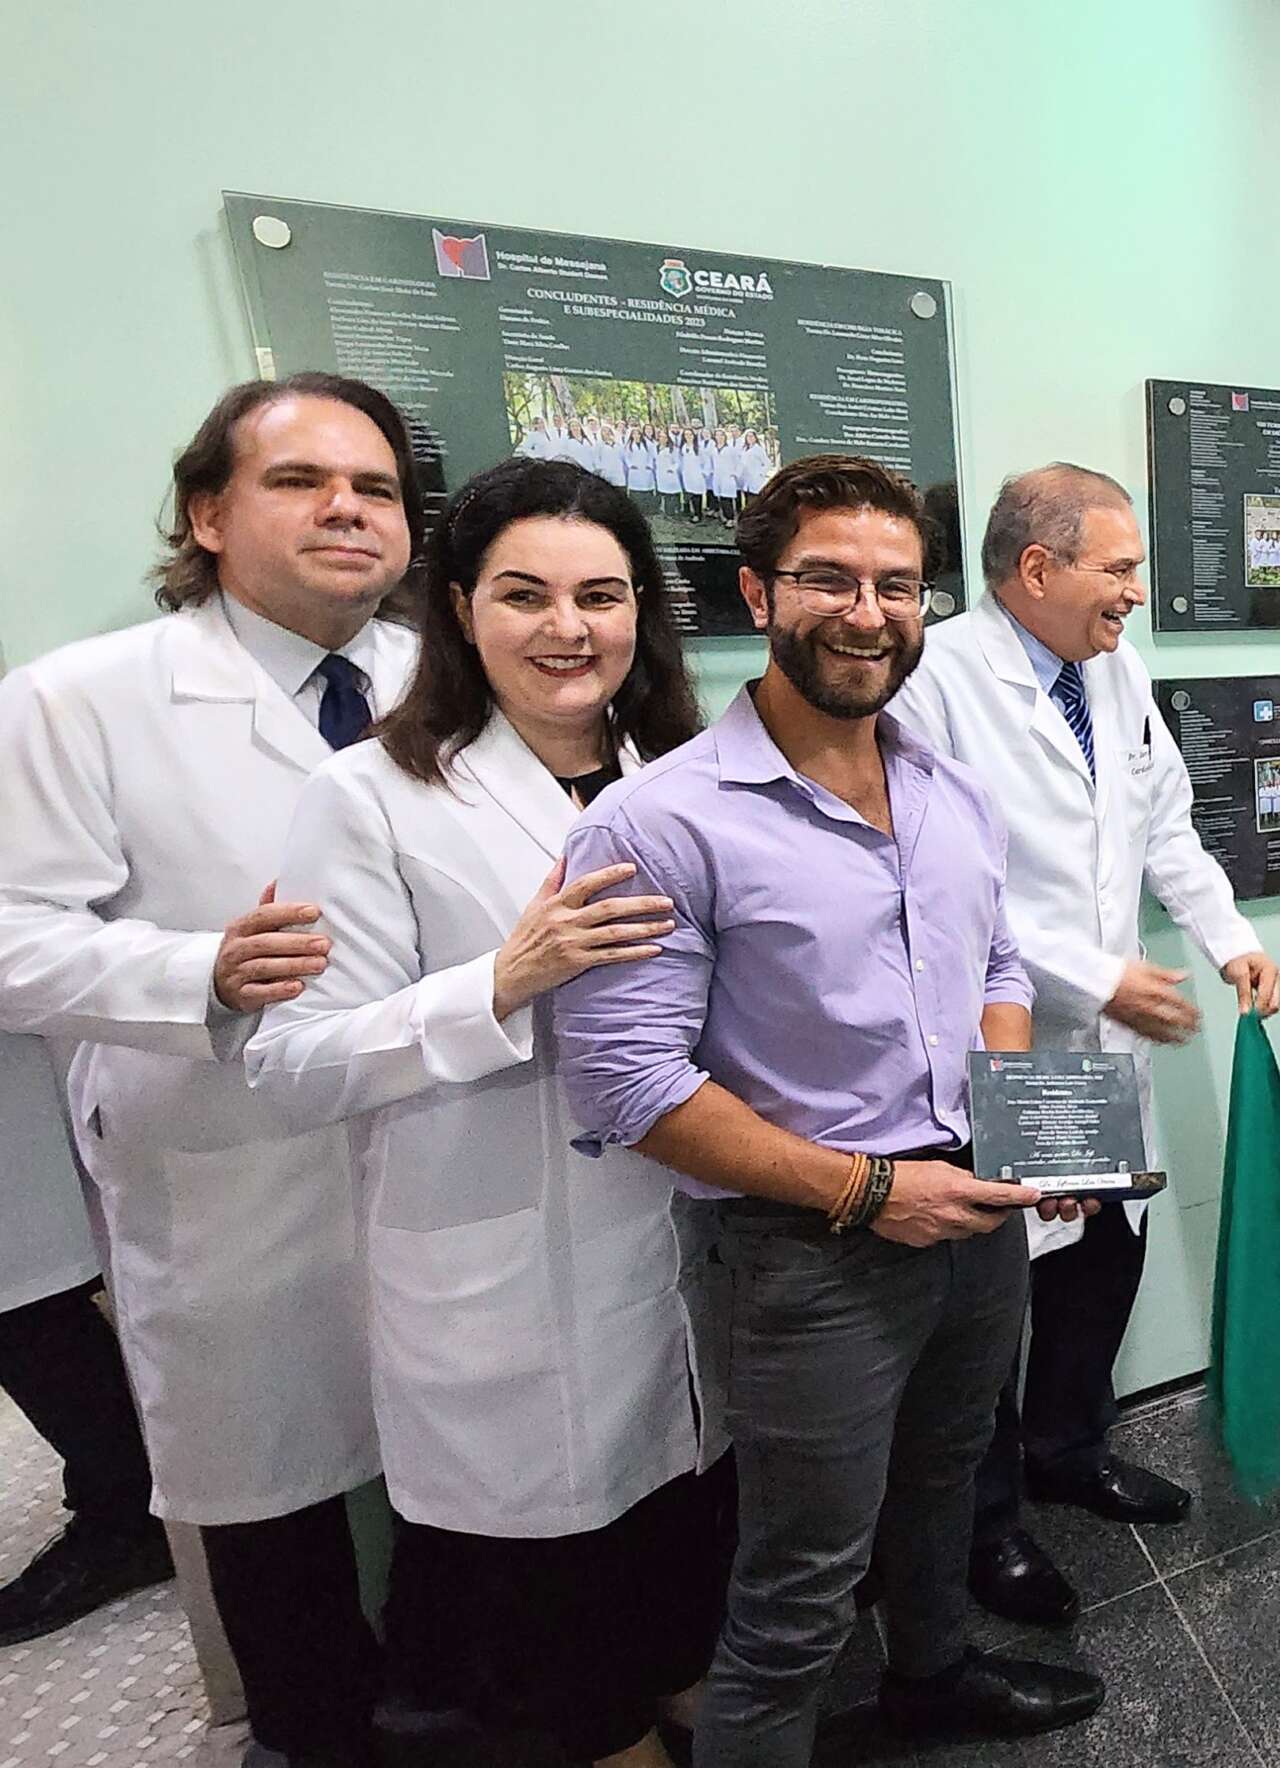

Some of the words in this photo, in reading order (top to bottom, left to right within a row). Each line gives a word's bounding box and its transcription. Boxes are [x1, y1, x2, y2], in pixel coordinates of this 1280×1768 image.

[496, 251, 538, 263] Hospital
[694, 270, 774, 294] CEARÁ
[695, 286, 731, 296] GOVERNO
[732, 290, 744, 298] DO
[745, 292, 774, 300] ESTADO
[526, 287, 618, 306] CONCLUDENTES
[627, 298, 693, 315] RESIDÊNCIA
[693, 303, 737, 319] MÉDICA
[563, 304, 572, 314] E
[572, 305, 684, 326] SUBESPECIALIDADES
